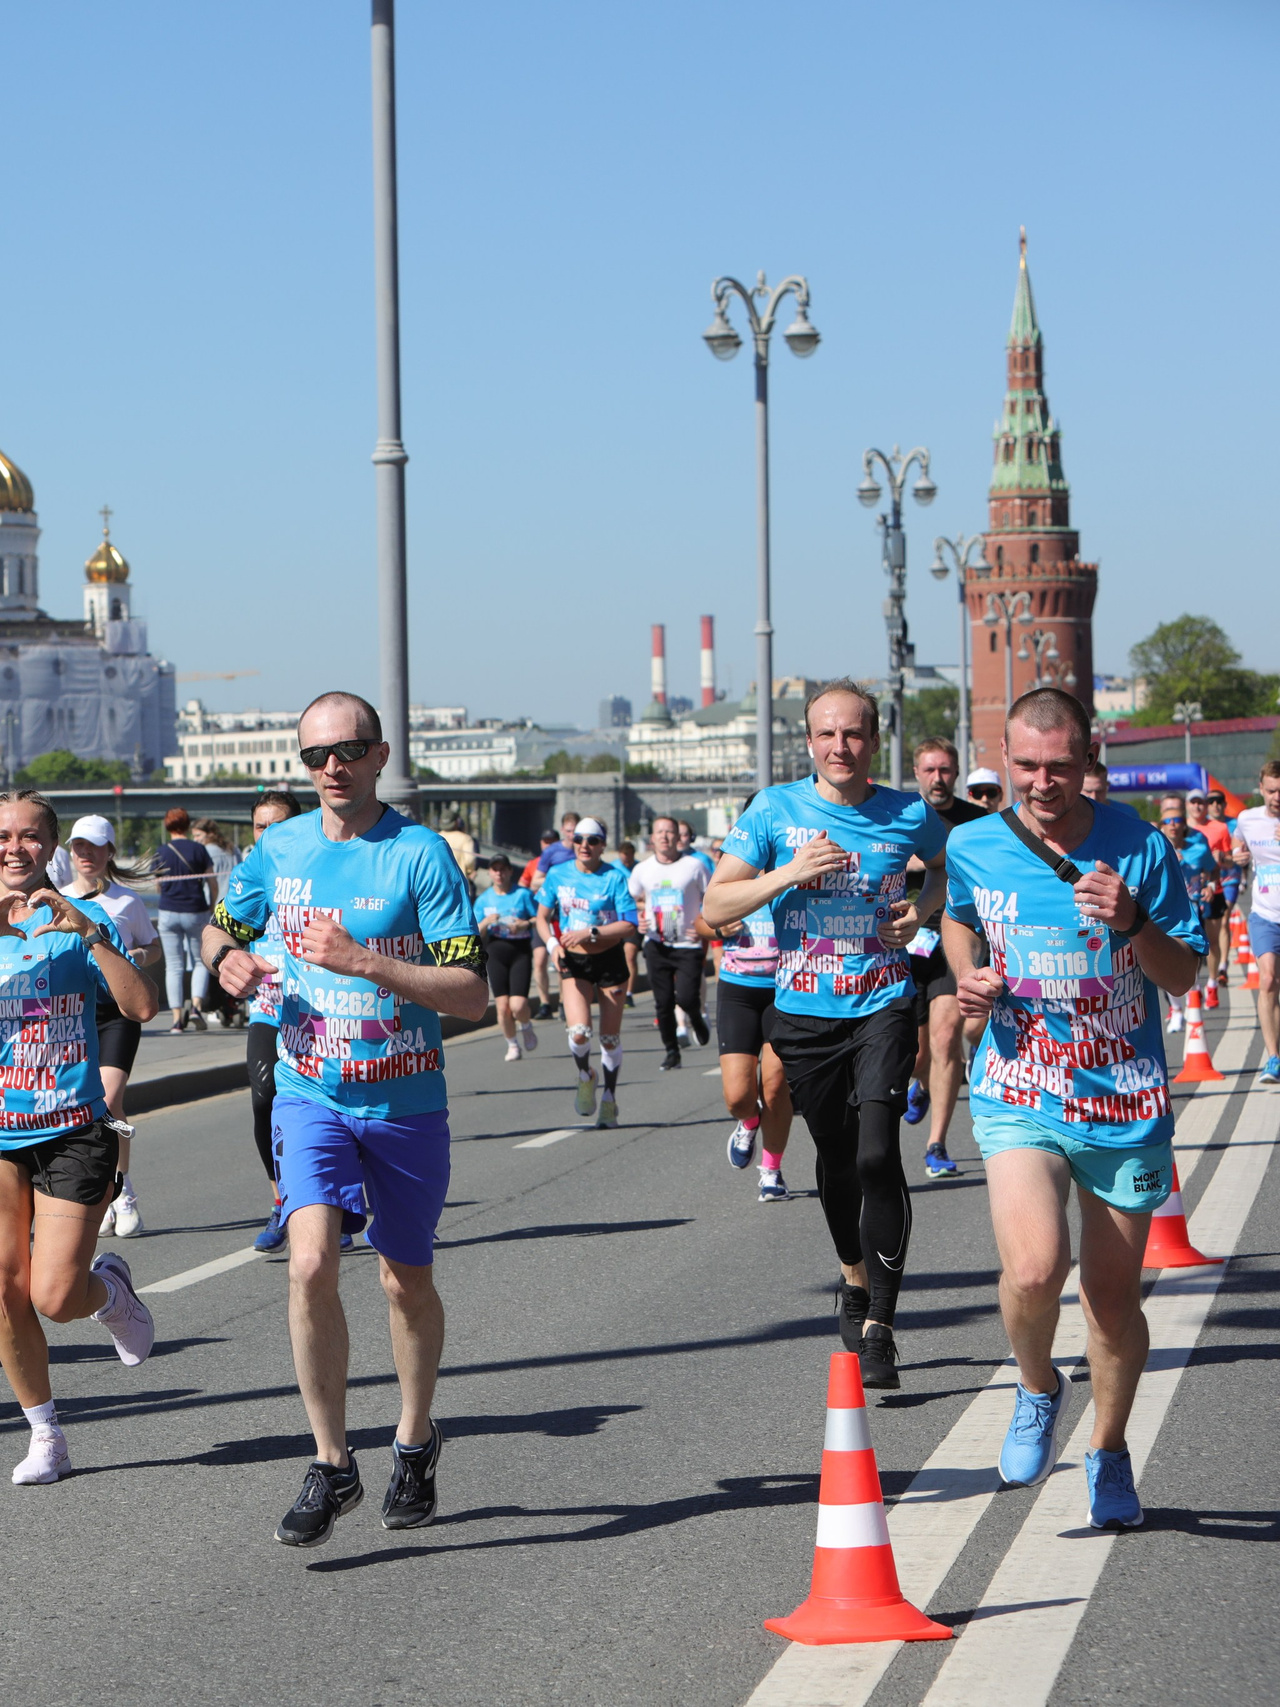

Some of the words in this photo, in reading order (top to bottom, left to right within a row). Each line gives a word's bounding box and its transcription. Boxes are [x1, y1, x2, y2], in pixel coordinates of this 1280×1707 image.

[785, 826, 828, 848] 202
[273, 877, 312, 905] 2024
[973, 886, 1019, 923] 2024
[823, 915, 874, 936] 30337
[832, 937, 865, 954] 10KM
[1090, 940, 1098, 949] E
[1028, 951, 1088, 977] 36116
[1038, 978, 1081, 999] 10KM
[314, 987, 375, 1016] 34262
[324, 1017, 362, 1040] 10KM
[1016, 1033, 1135, 1070] #ГОРДОСТЬ
[1111, 1055, 1165, 1094] 2024
[34, 1088, 78, 1113] 2024
[1133, 1170, 1159, 1184] MONT
[1134, 1180, 1161, 1193] BLANC
